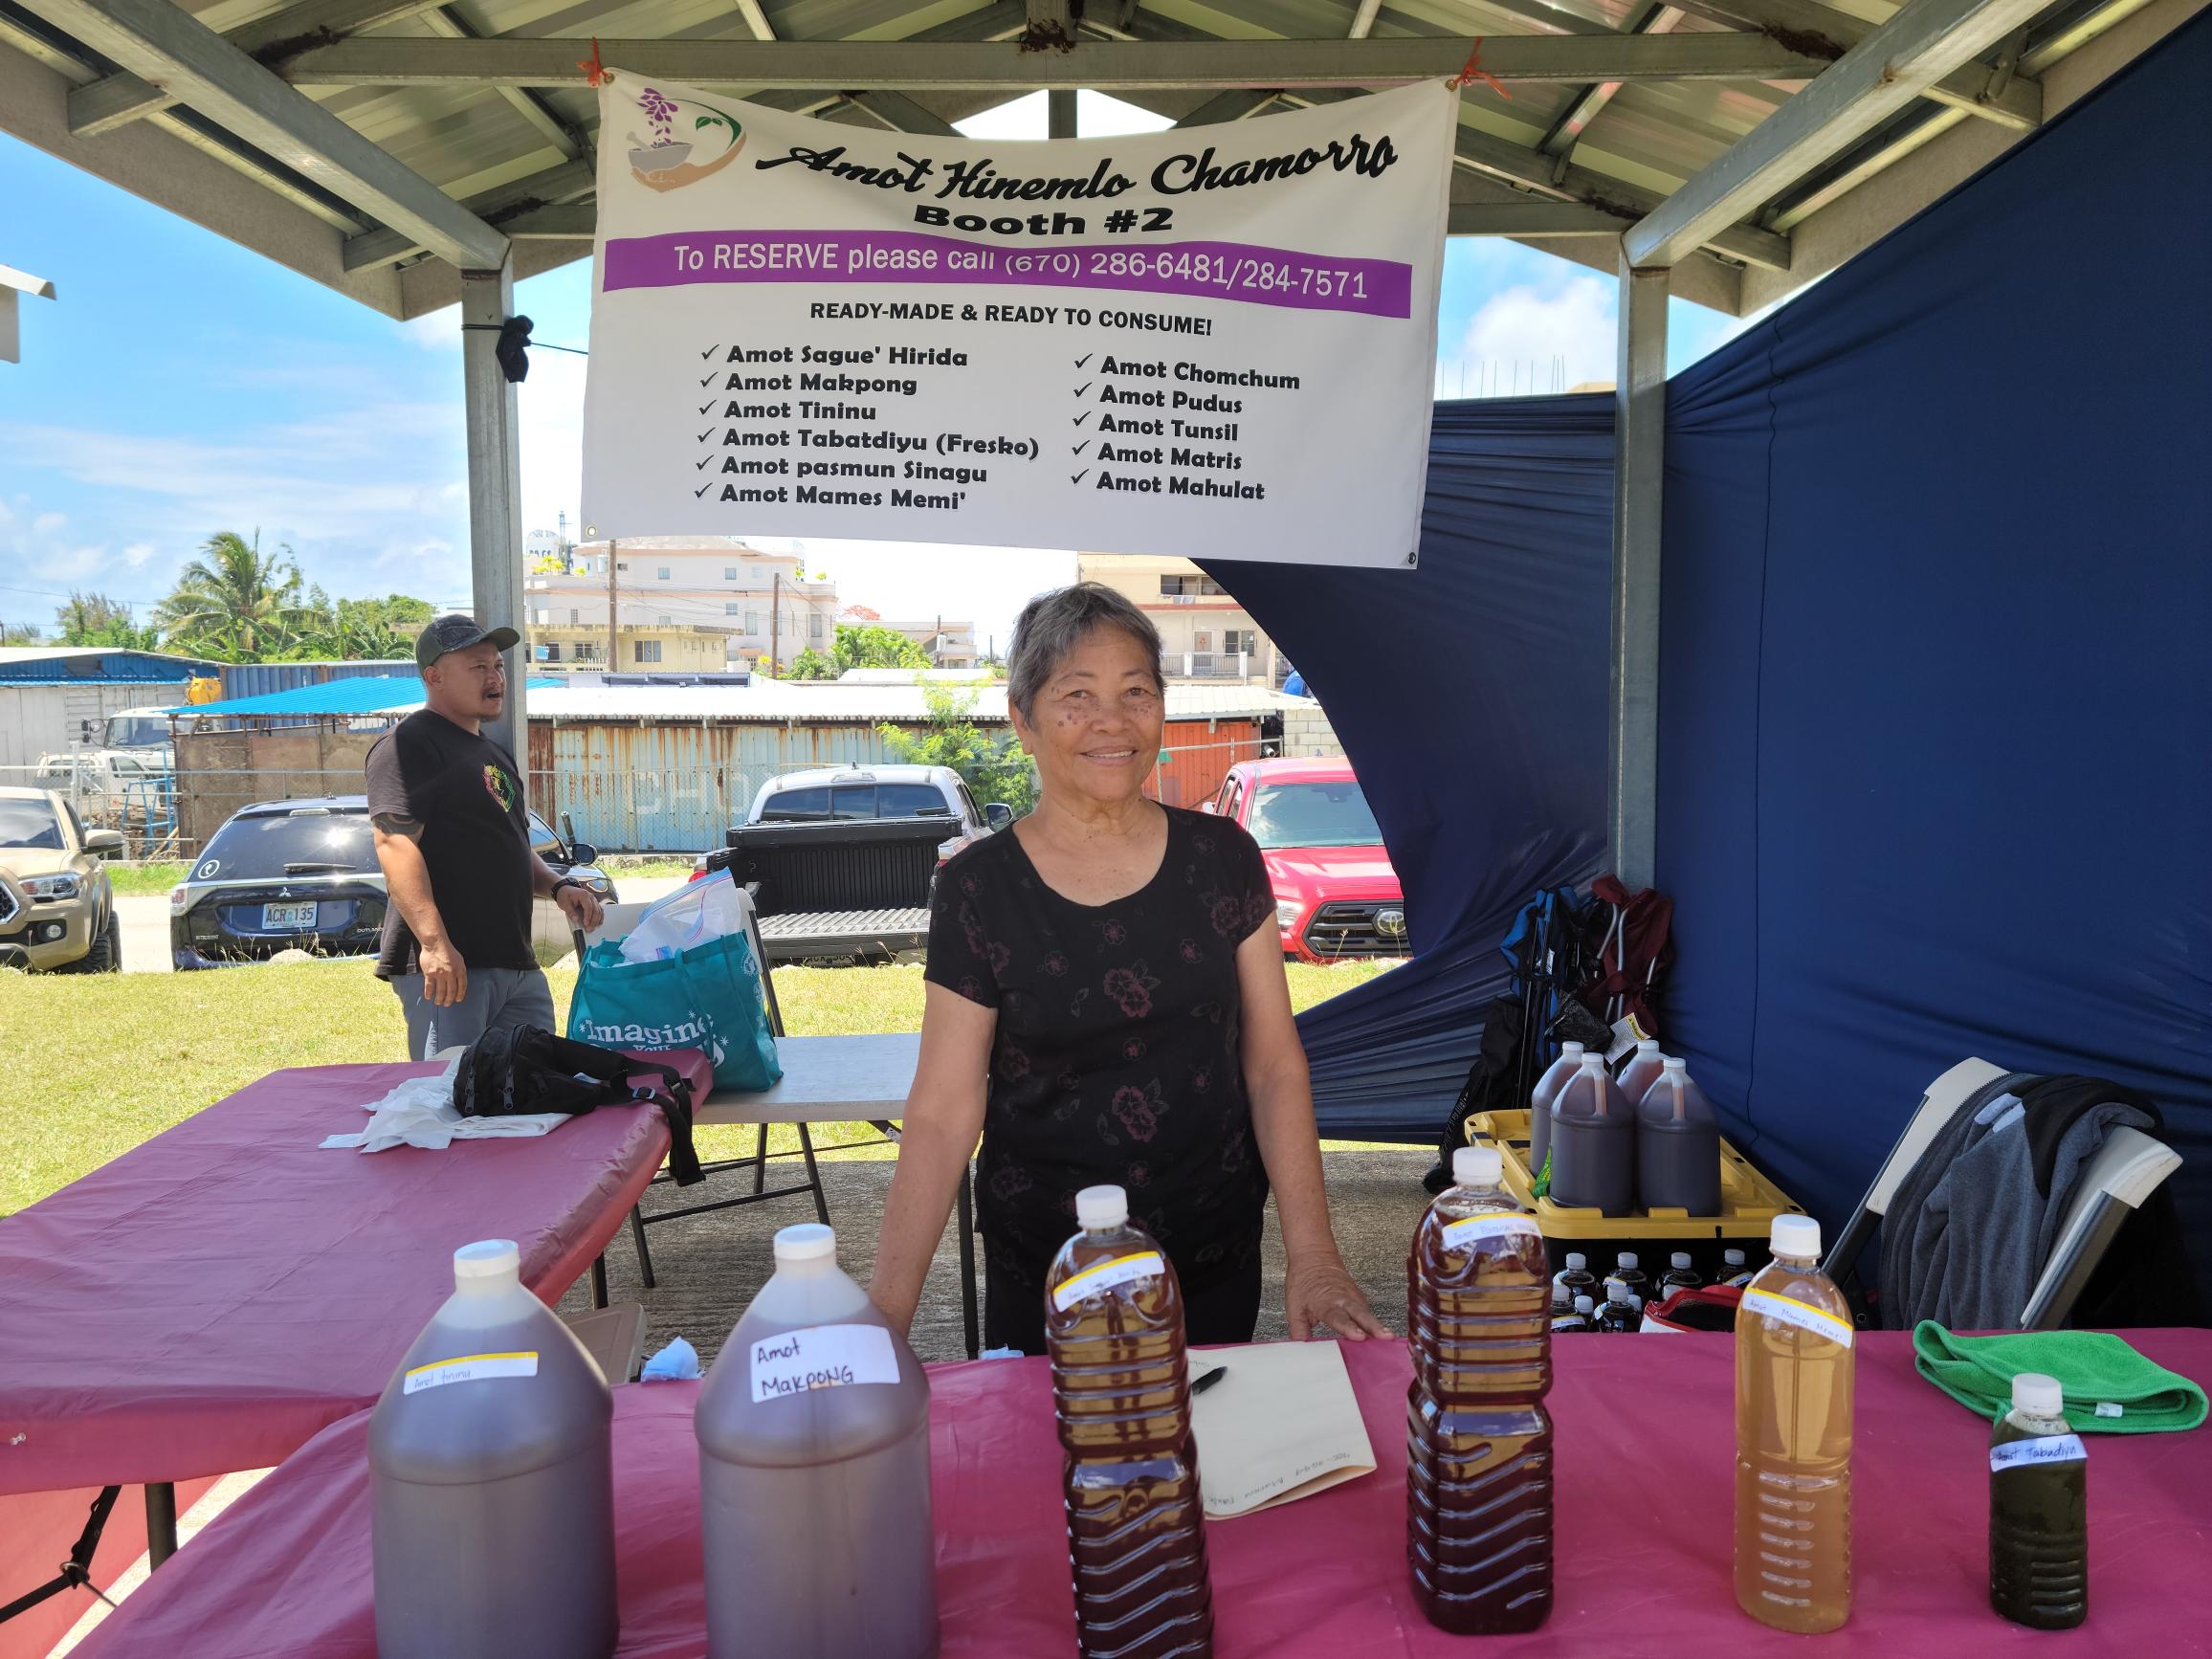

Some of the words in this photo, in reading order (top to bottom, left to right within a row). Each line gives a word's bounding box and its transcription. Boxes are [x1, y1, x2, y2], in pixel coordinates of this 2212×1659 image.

[755, 145, 934, 193] Amot
[934, 157, 1138, 201] Hinemlo
[1150, 133, 1399, 195] Chamorro
[913, 204, 1086, 235] Booth
[1103, 207, 1174, 233] #2
[674, 245, 704, 271] To
[714, 242, 839, 269] RESERVE
[848, 243, 939, 275] please
[947, 250, 995, 270] call
[1005, 254, 1080, 278] (670)
[1090, 252, 1368, 299] 286-6481/284-7571
[810, 302, 955, 321] READY-MADE
[961, 303, 978, 321] &
[984, 304, 1059, 324] READY
[1064, 307, 1092, 326] TO
[1098, 310, 1212, 337] CONSUME!
[726, 344, 794, 364] Amot
[800, 344, 881, 366] Sague'
[888, 346, 968, 366] Hirida
[724, 372, 792, 391] Amot
[800, 372, 918, 396] Makpong
[1099, 355, 1167, 379] Amot
[1173, 361, 1300, 390] Chomchum
[723, 400, 791, 419] Amot
[798, 400, 876, 420] Tininu
[1098, 384, 1165, 408] Amot
[1172, 389, 1243, 413] Pudus
[1097, 412, 1164, 436] Amot
[1170, 419, 1239, 442] Tunsil
[721, 428, 790, 447] Amot
[797, 429, 927, 453] Tabatdiyu
[936, 432, 1039, 461] (Fresko)
[1096, 442, 1163, 465] Amot
[1170, 447, 1243, 470] Matris
[720, 455, 789, 475] Amot
[797, 461, 896, 478] pasmun
[903, 459, 987, 484] Sinagu
[719, 483, 788, 503] Amot
[795, 485, 883, 506] Mames
[891, 488, 966, 510] Memi'
[1095, 471, 1162, 494] Amot
[1168, 476, 1265, 500] Mahulat
[266, 908, 287, 922] ACR
[296, 907, 315, 921] 135
[757, 1337, 801, 1364] Amot
